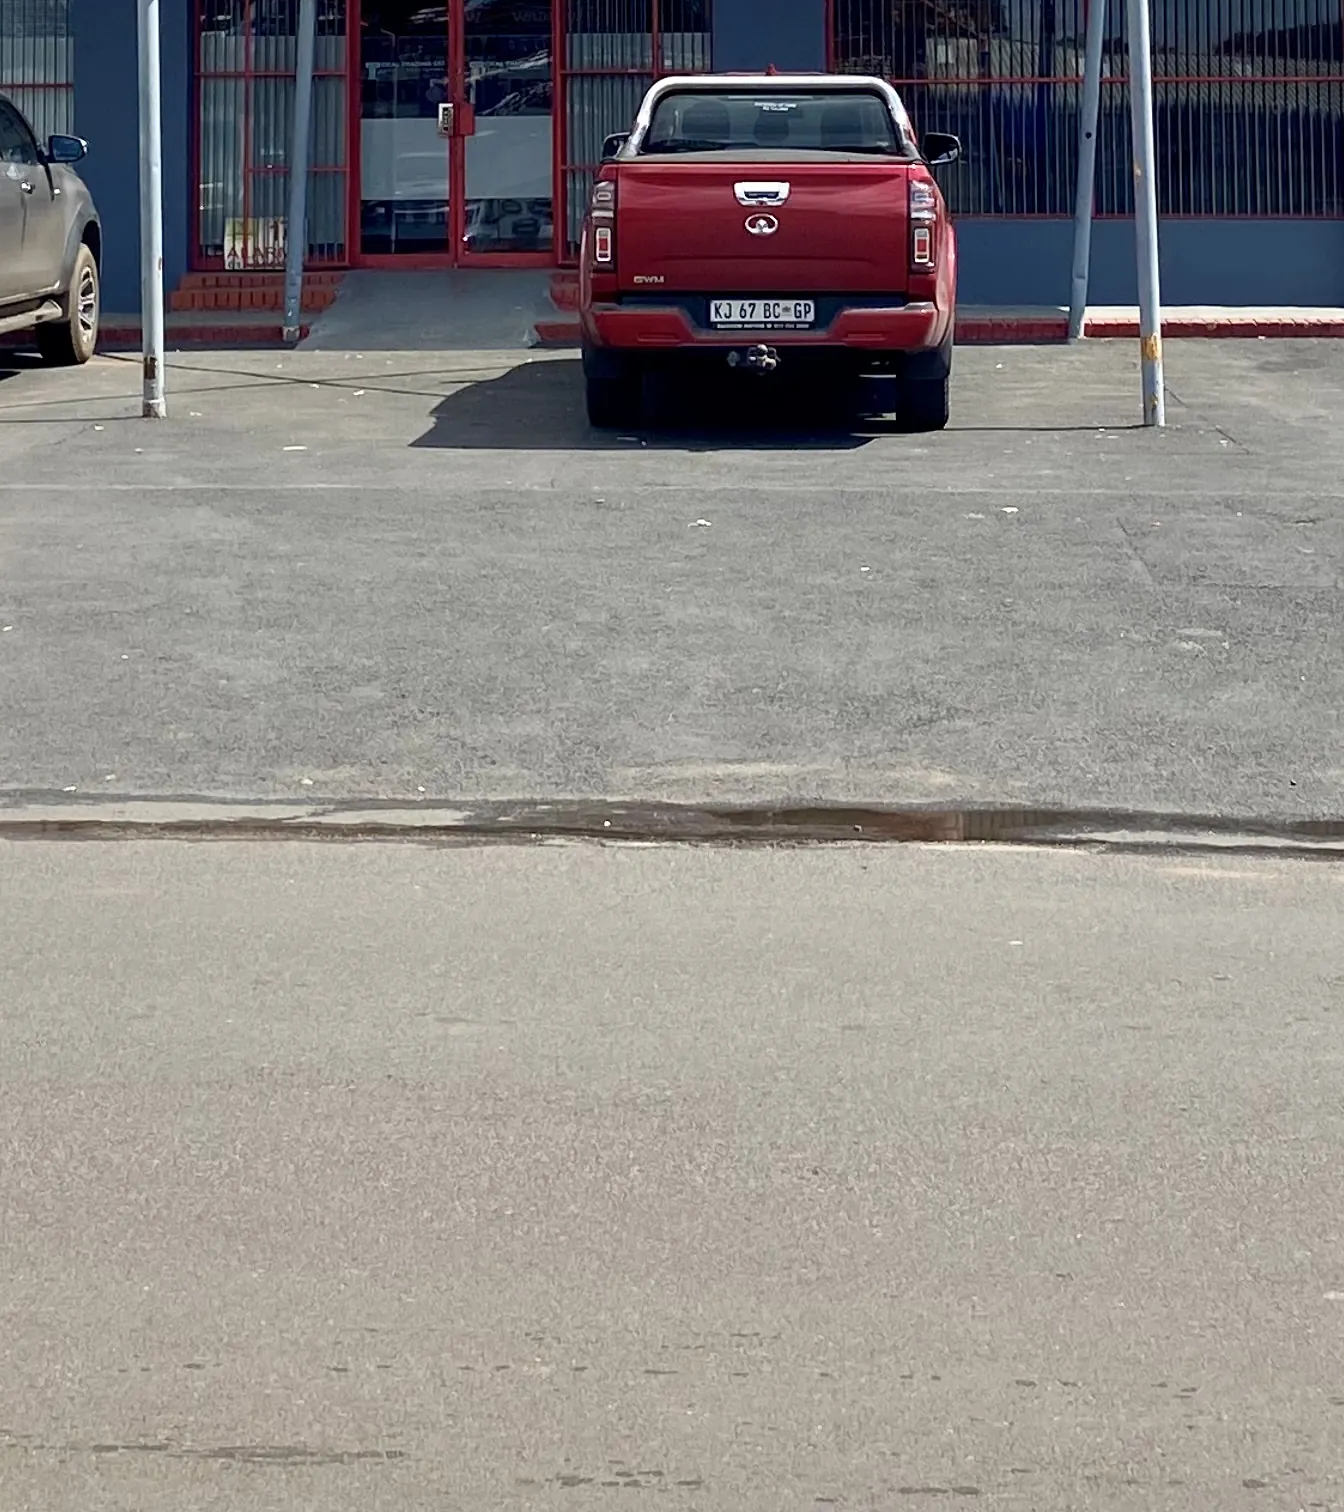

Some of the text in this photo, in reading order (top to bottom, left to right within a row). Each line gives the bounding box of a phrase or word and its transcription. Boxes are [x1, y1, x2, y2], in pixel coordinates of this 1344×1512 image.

[714, 302, 812, 319] KJ 67 BC GP
